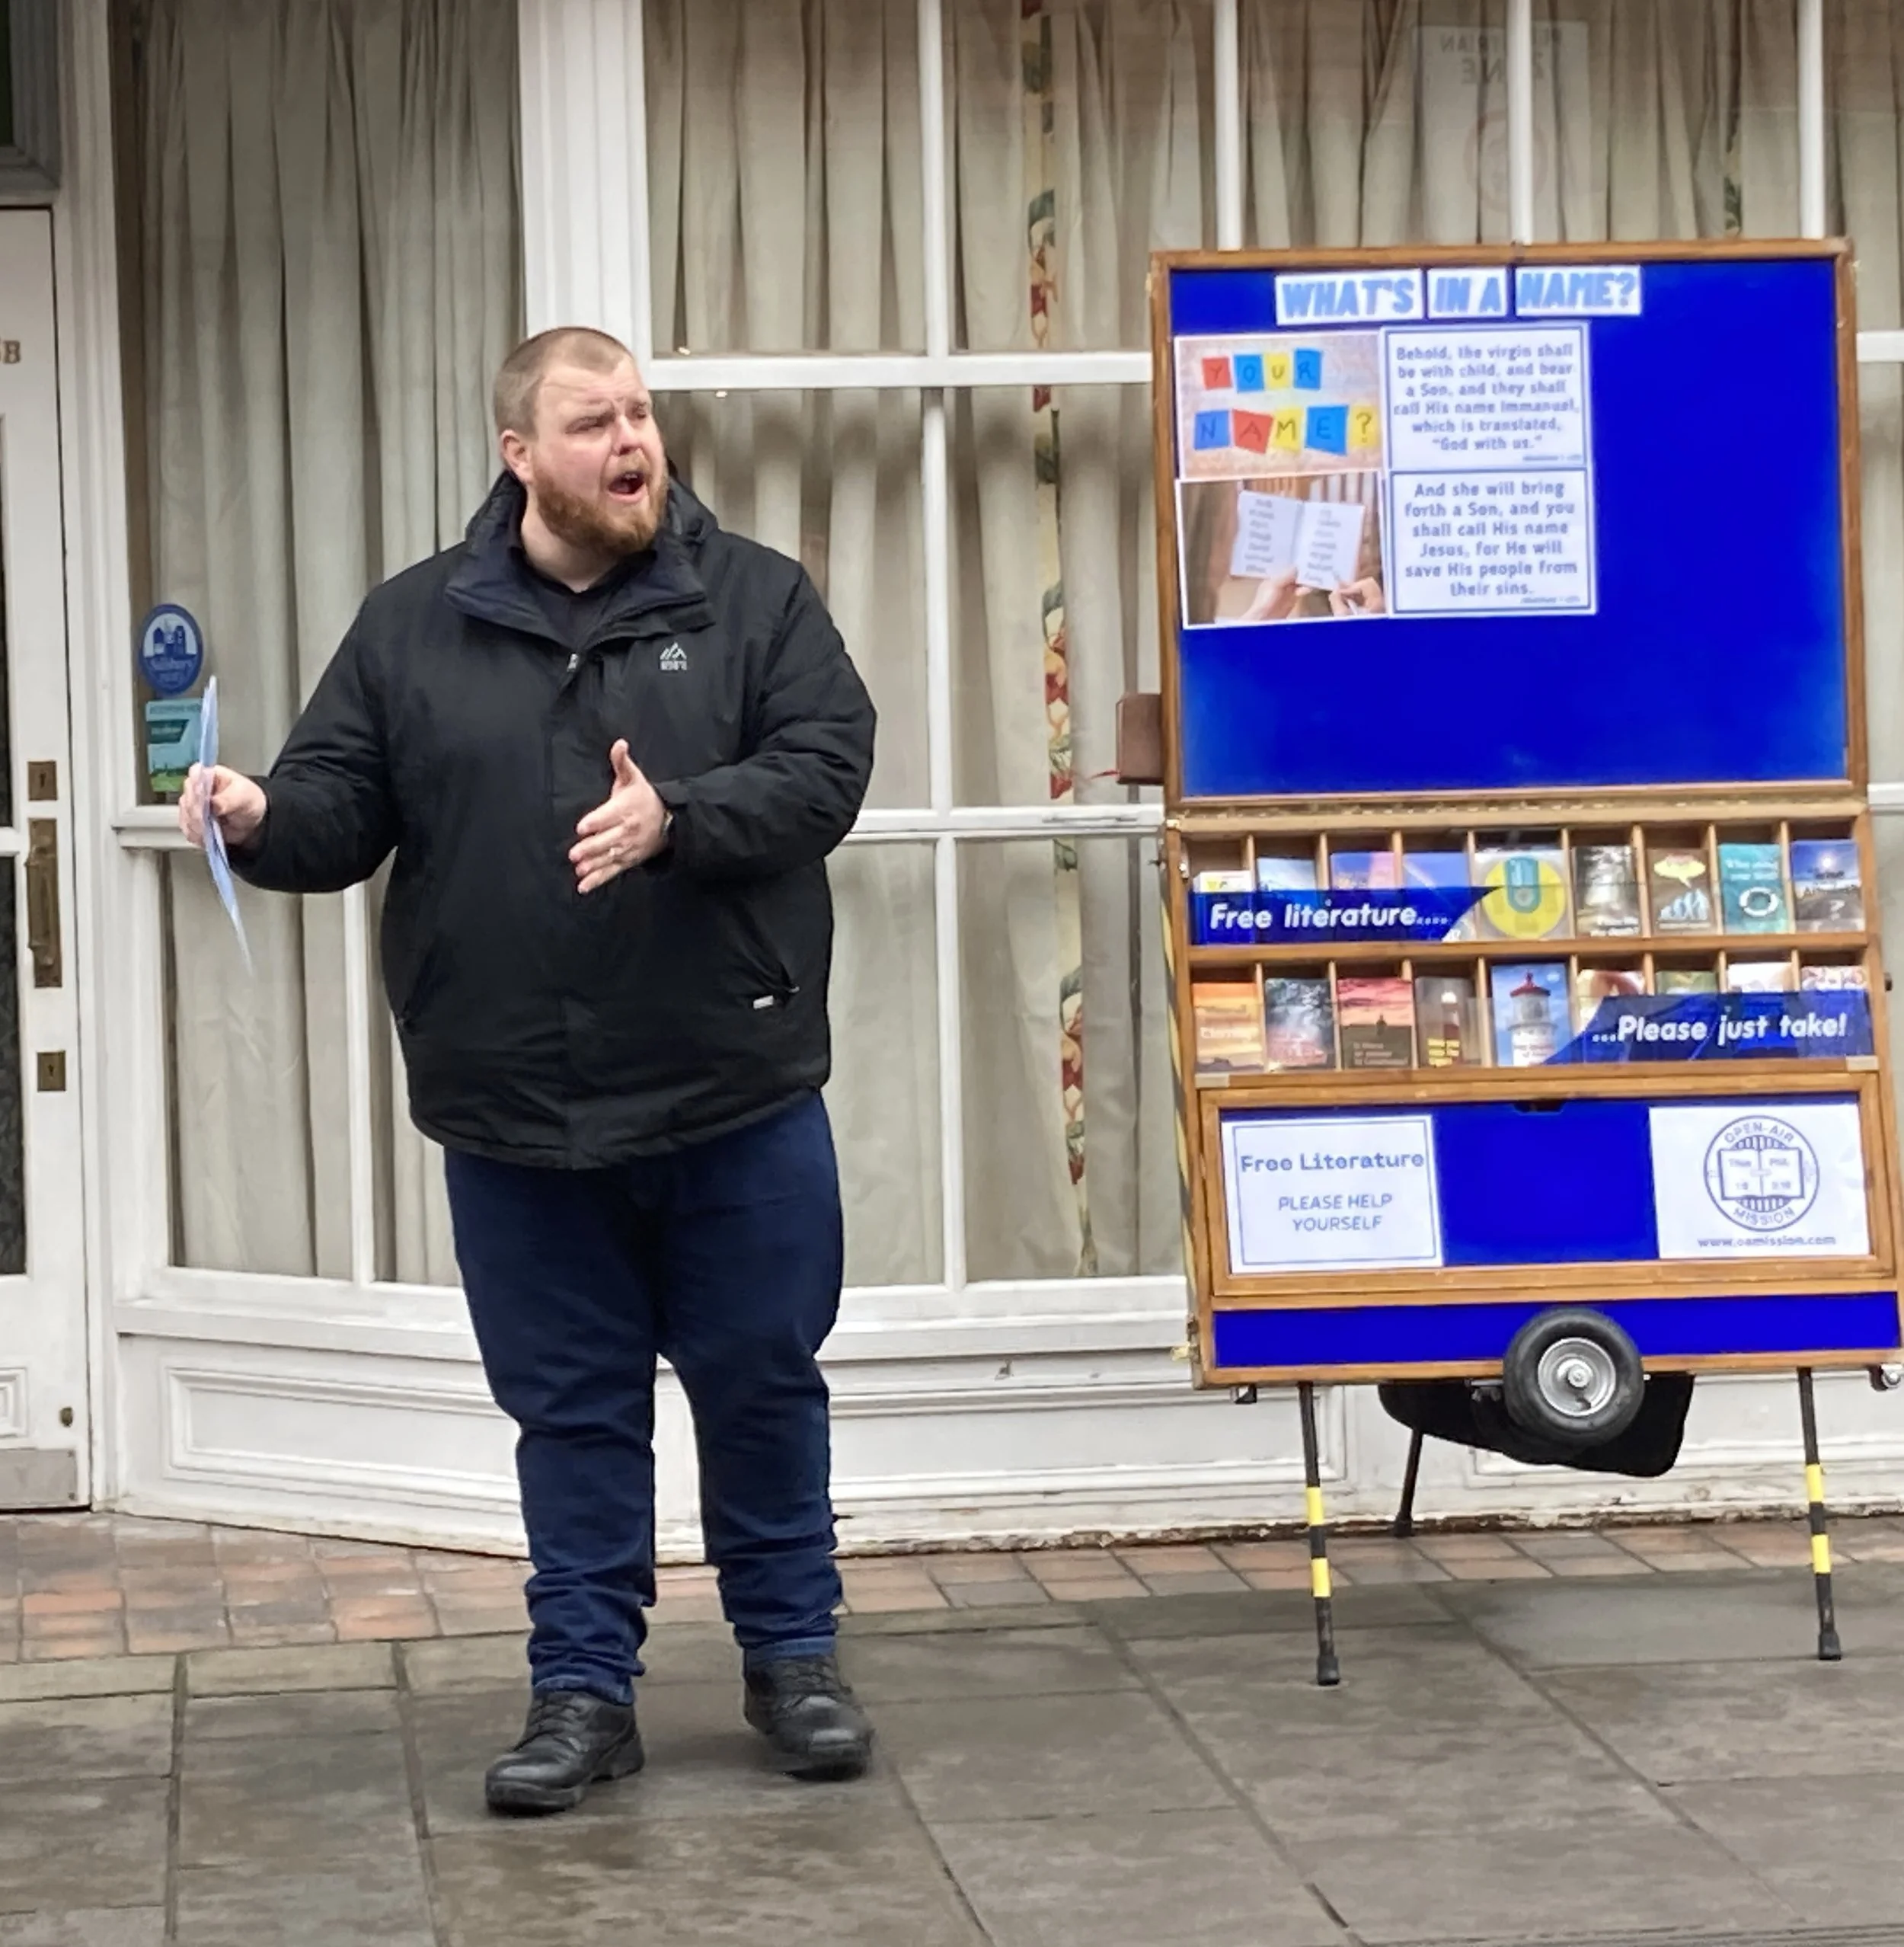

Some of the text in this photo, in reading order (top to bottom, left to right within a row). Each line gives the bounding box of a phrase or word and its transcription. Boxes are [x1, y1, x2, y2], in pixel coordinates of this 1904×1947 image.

[1282, 272, 1635, 318] WHAT'S IN A NAME?
[1396, 343, 1573, 362] Behold, the virgin shall
[1209, 361, 1316, 383] YOUR
[1398, 362, 1573, 379] be with child, and bear
[1406, 379, 1567, 398] a Son, and they shall
[1394, 398, 1580, 415] call His name Immanuel,
[1412, 417, 1561, 433] which is translated,
[1414, 481, 1565, 498] And she will bring
[1404, 501, 1575, 519] forth a Son, and you
[1412, 522, 1569, 537] shall call His name
[1420, 540, 1562, 558] Jesus, for He will
[1404, 560, 1577, 579] save His people from
[1450, 582, 1535, 596] their sins.
[1210, 903, 1272, 929] Free
[1593, 1012, 1847, 1046] ...Please just take!
[1724, 1122, 1794, 1143] OPEN-AIR
[1241, 1152, 1424, 1172] Free Literature
[1279, 1193, 1393, 1210] PLEASE HELP
[1292, 1215, 1383, 1232] YOURSELF
[1733, 1207, 1795, 1226] MISSION
[1697, 1235, 1836, 1248] www.oamission.com
